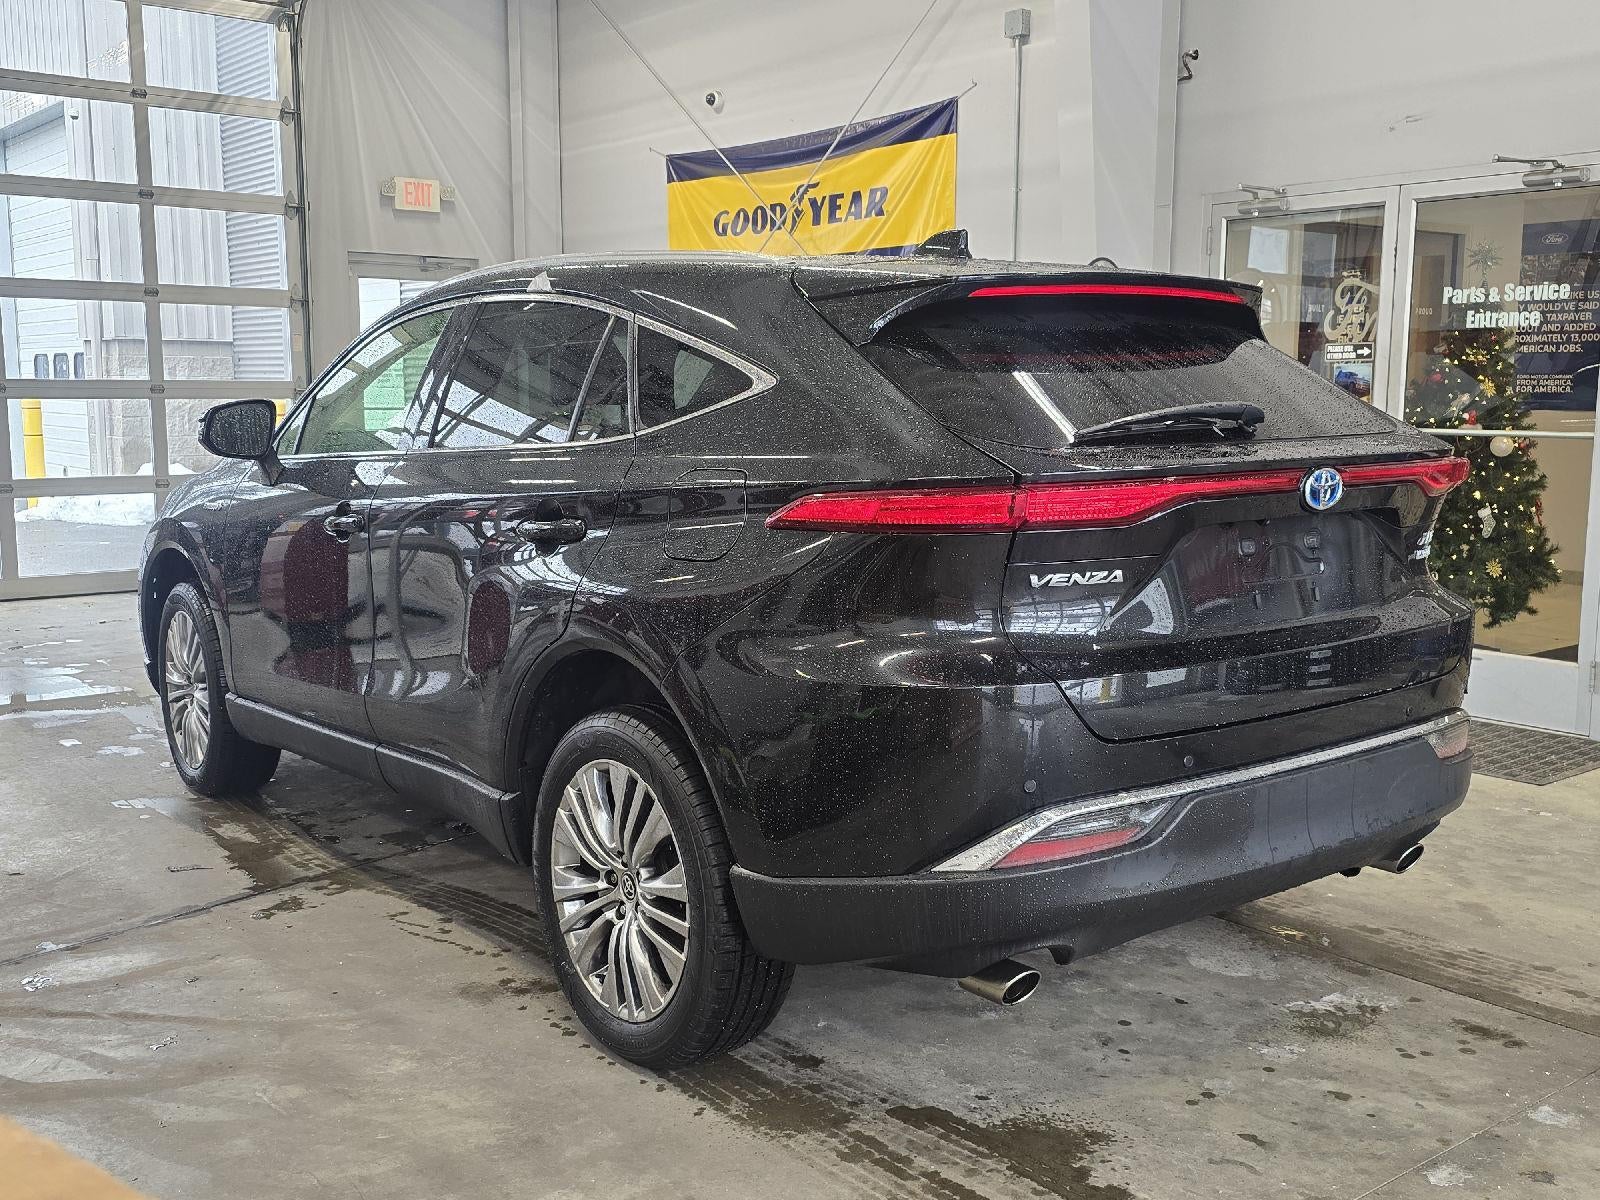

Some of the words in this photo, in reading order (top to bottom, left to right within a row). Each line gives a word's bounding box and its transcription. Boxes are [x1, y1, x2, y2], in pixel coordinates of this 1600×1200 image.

[403, 181, 433, 208] EXIT
[1545, 233, 1565, 243] Ford
[1442, 286, 1486, 305] Parts
[1488, 285, 1501, 303] &
[1504, 282, 1571, 302] Service
[1568, 290, 1585, 300] IKE
[1527, 301, 1576, 312] WOULD'VE
[1578, 301, 1600, 310] SAID
[1465, 310, 1541, 329] Entrance
[1546, 311, 1593, 321] TAXPAYER
[1541, 323, 1561, 332] AND
[1563, 322, 1597, 331] ADDED
[1514, 333, 1569, 343] ROXIMATELY
[1570, 333, 1600, 343] 13,000
[1515, 344, 1556, 353] MERICAN
[1557, 344, 1584, 353] JOBS.
[1516, 385, 1533, 393] FOR
[1533, 385, 1574, 393] AMERICA.
[1029, 569, 1124, 589] VENZA
